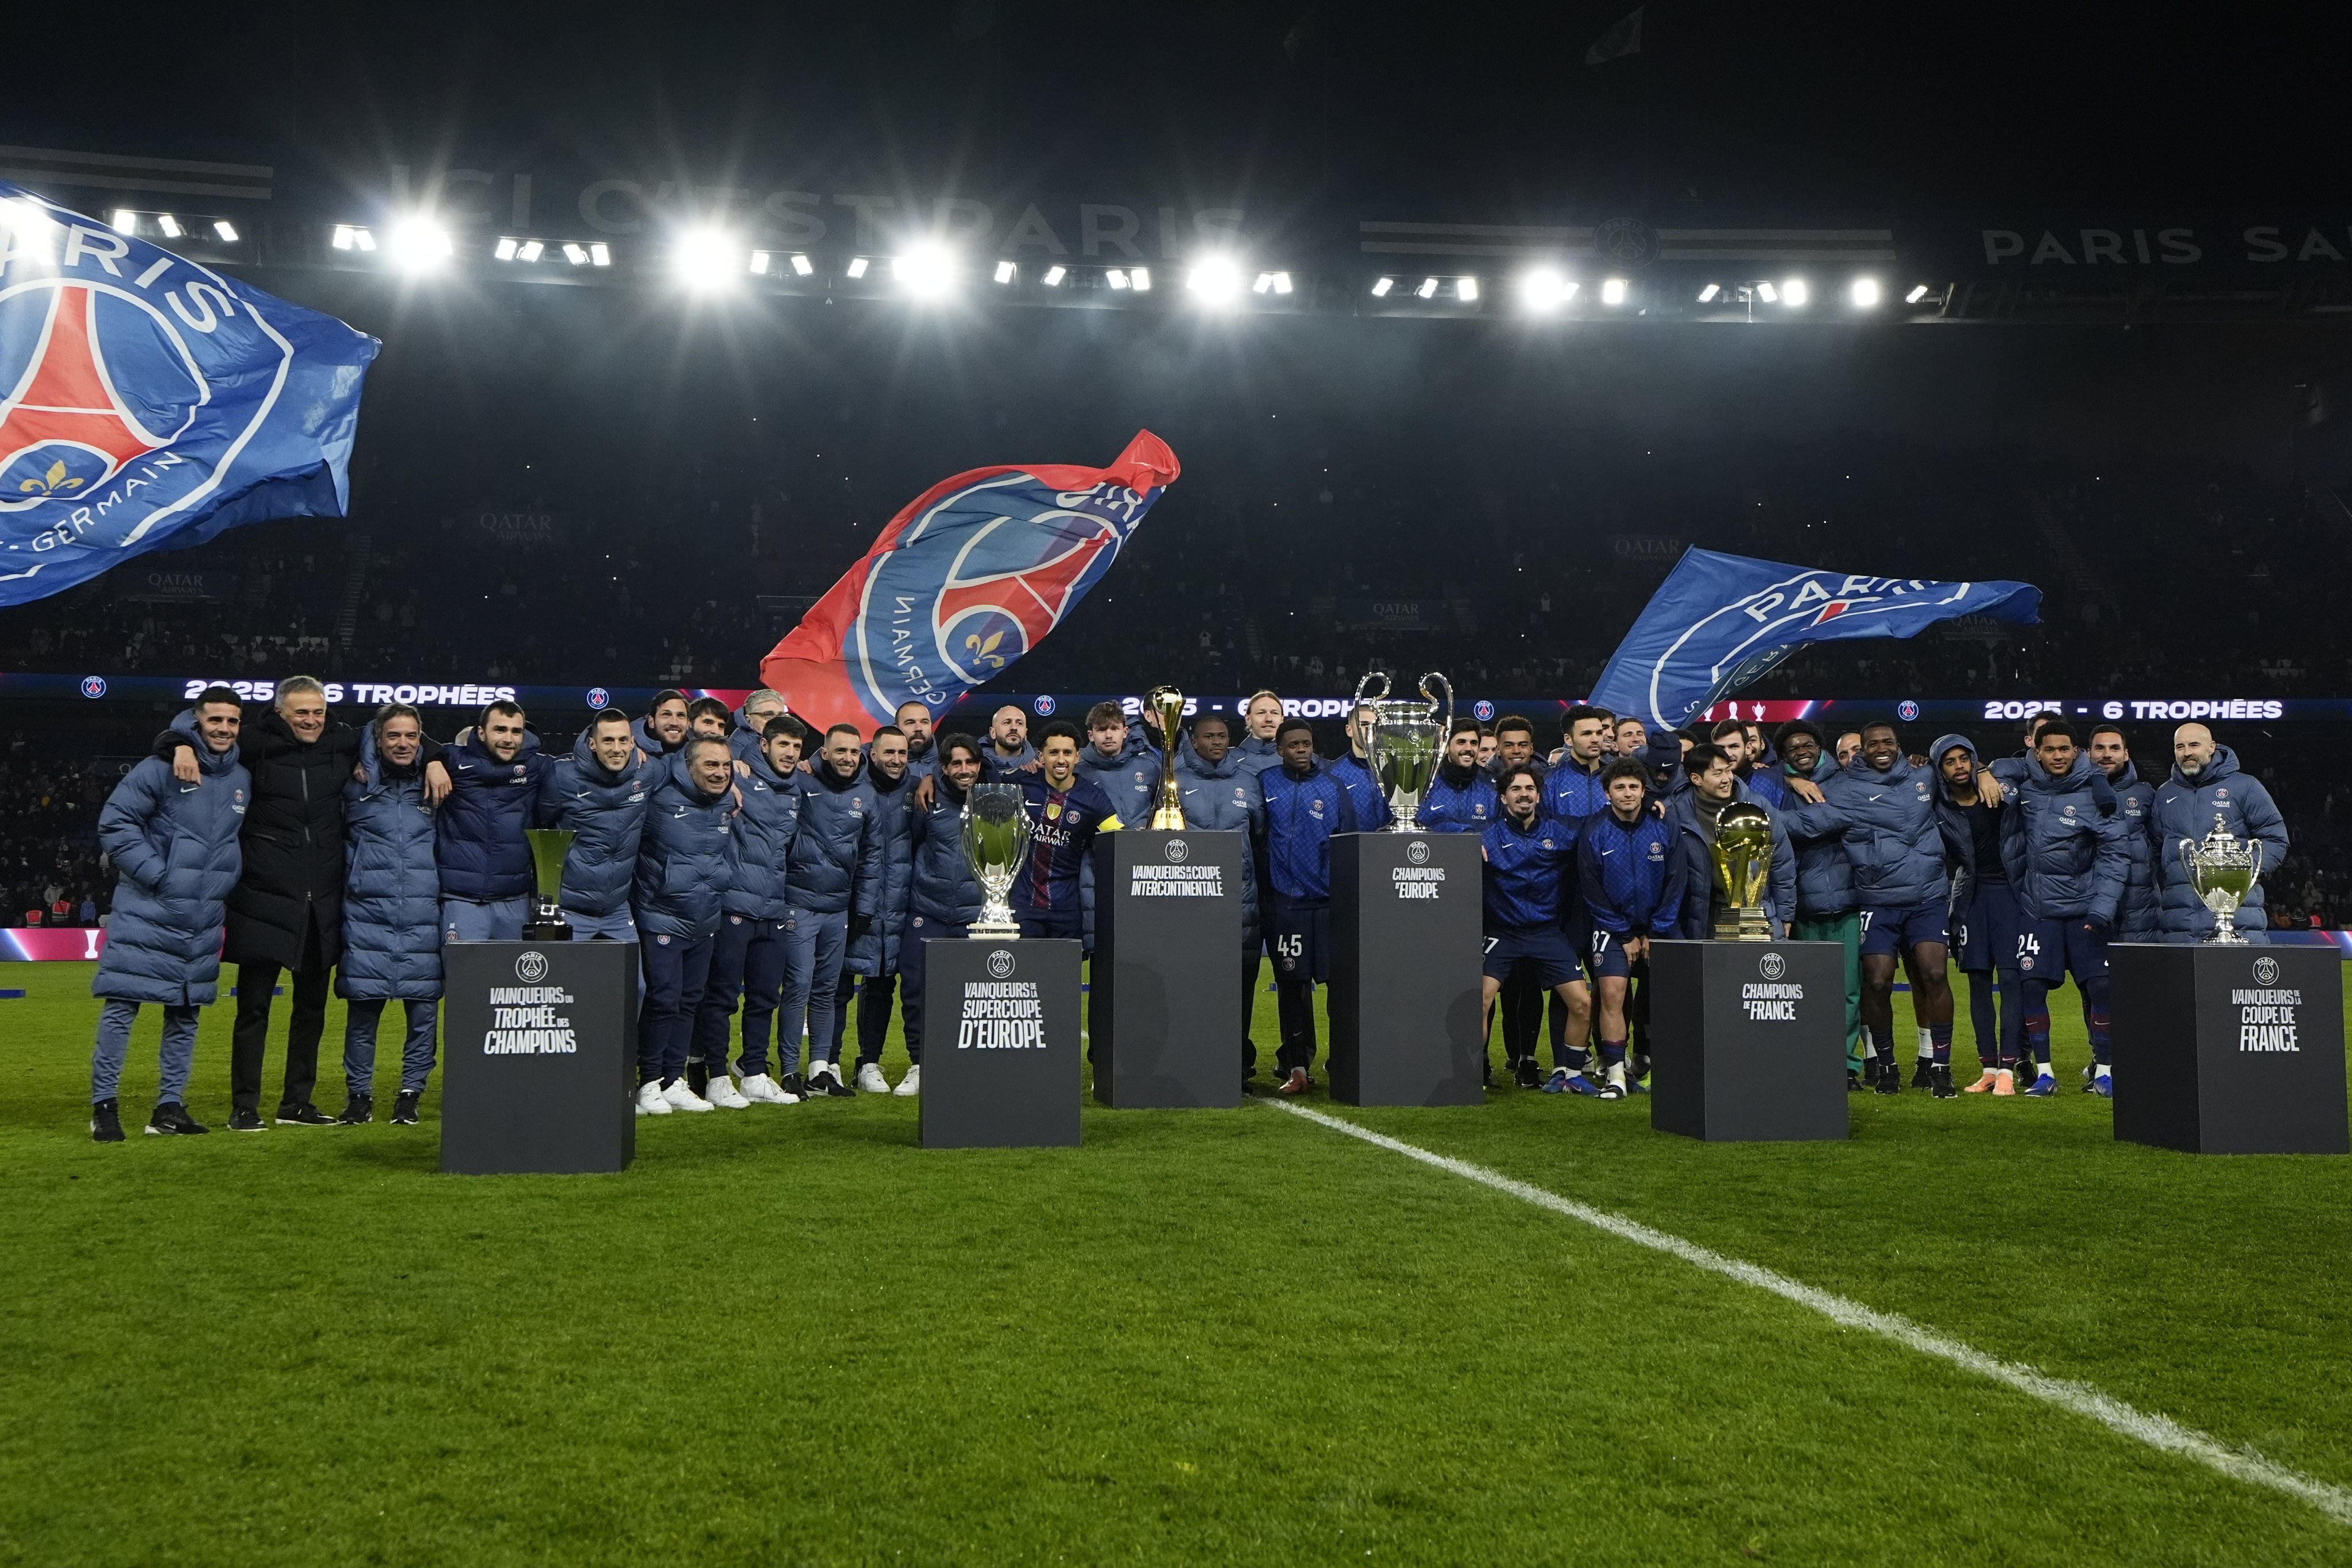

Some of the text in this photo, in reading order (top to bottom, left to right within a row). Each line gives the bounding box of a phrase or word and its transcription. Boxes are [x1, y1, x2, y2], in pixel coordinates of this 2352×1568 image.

[1982, 226, 2352, 265] PARIS SA
[480, 513, 552, 532] QATAR
[1615, 540, 1680, 556] QATAR
[149, 574, 203, 588] QATAR
[161, 586, 203, 594] AIRWAYS
[1373, 603, 1419, 615] QATAR
[322, 683, 344, 702] 6
[353, 684, 514, 705] TROPHÉES
[1984, 701, 2062, 719] 2025
[2103, 701, 2123, 719] 6
[2131, 699, 2283, 719] TROPHÉES
[629, 792, 644, 802] QATAR
[1033, 834, 1070, 846] AIRWAYS
[1132, 865, 1186, 880] VAINQUEURS
[1192, 866, 1221, 880] COUPE
[1392, 868, 1445, 881] CHAMPIONS
[1131, 881, 1224, 896] INTERCONTINENTALE
[1592, 930, 1611, 952] 87
[1959, 924, 1968, 946] 9
[1278, 934, 1302, 957] 45
[1483, 936, 1499, 954] 7
[2017, 933, 2040, 957] 24
[521, 953, 543, 961] PARIS
[992, 951, 1011, 959] PARIS
[490, 987, 565, 1005] VAINQUEURS
[965, 982, 1030, 999] VAINQUEURS
[1031, 990, 1038, 998] LA
[1742, 983, 1804, 999] CHAMPIONS
[2232, 989, 2294, 1005] VAINQUEURS
[2295, 997, 2302, 1005] LA
[494, 1005, 570, 1028] TROPHÉE DES
[962, 1000, 1042, 1019] SUPERCOUPE
[1743, 1001, 1796, 1020] DE FRANCE
[2242, 1006, 2296, 1024] COUPE DE
[484, 1029, 577, 1054] CHAMPIONS
[958, 1020, 1046, 1048] D'EUROPE
[2240, 1025, 2300, 1051] FRANCE
